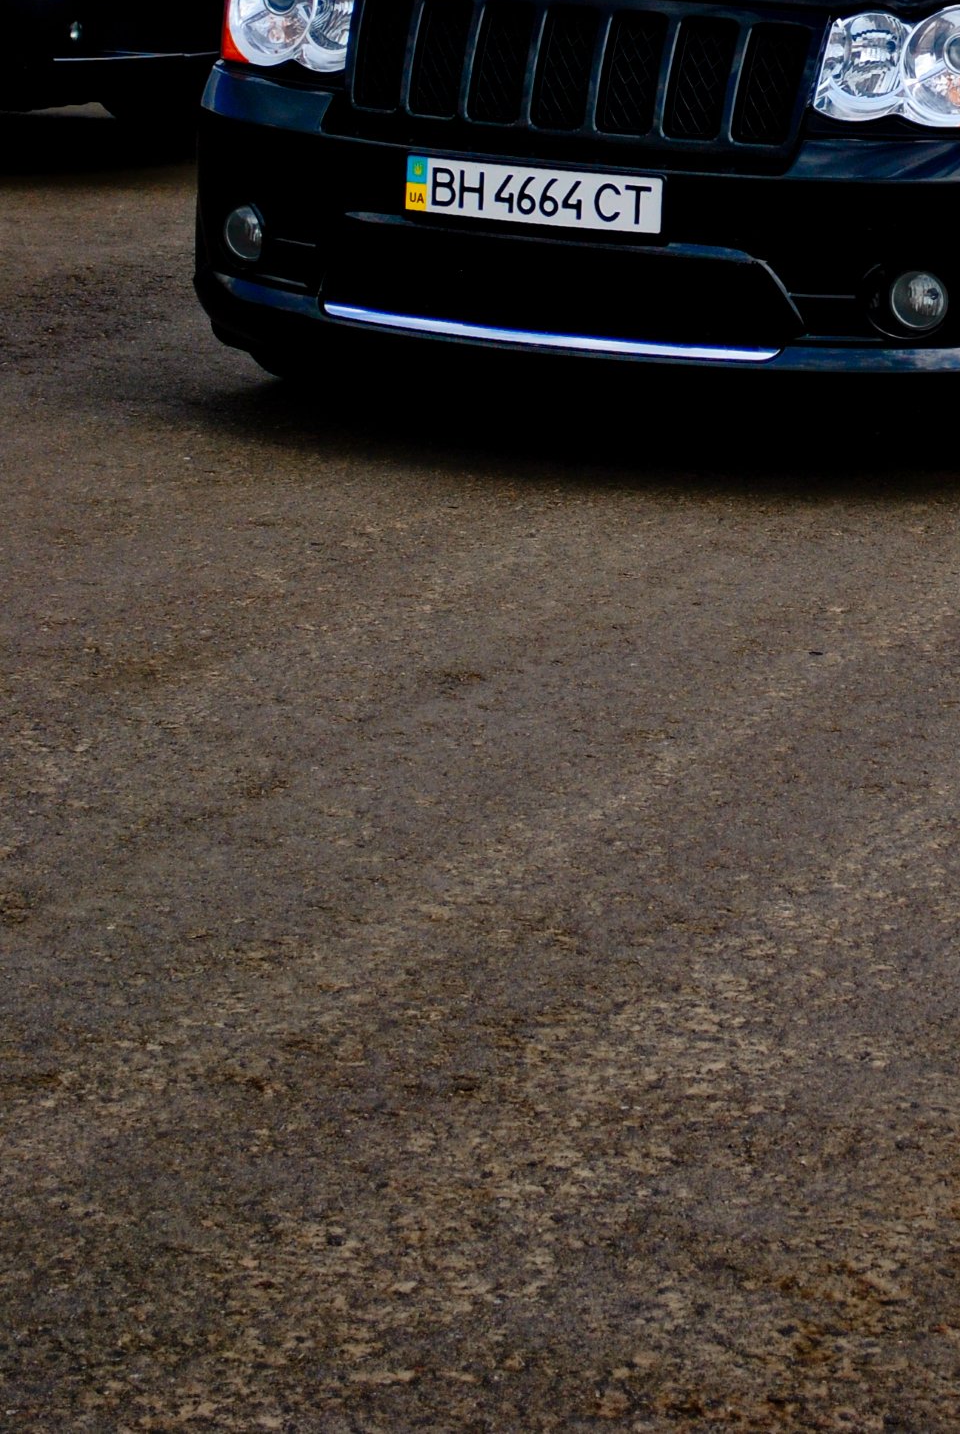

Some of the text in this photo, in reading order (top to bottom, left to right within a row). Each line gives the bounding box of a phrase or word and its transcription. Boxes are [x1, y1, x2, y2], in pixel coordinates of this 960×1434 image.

[409, 192, 425, 204] UA
[430, 167, 652, 225] BH 4664 CT
